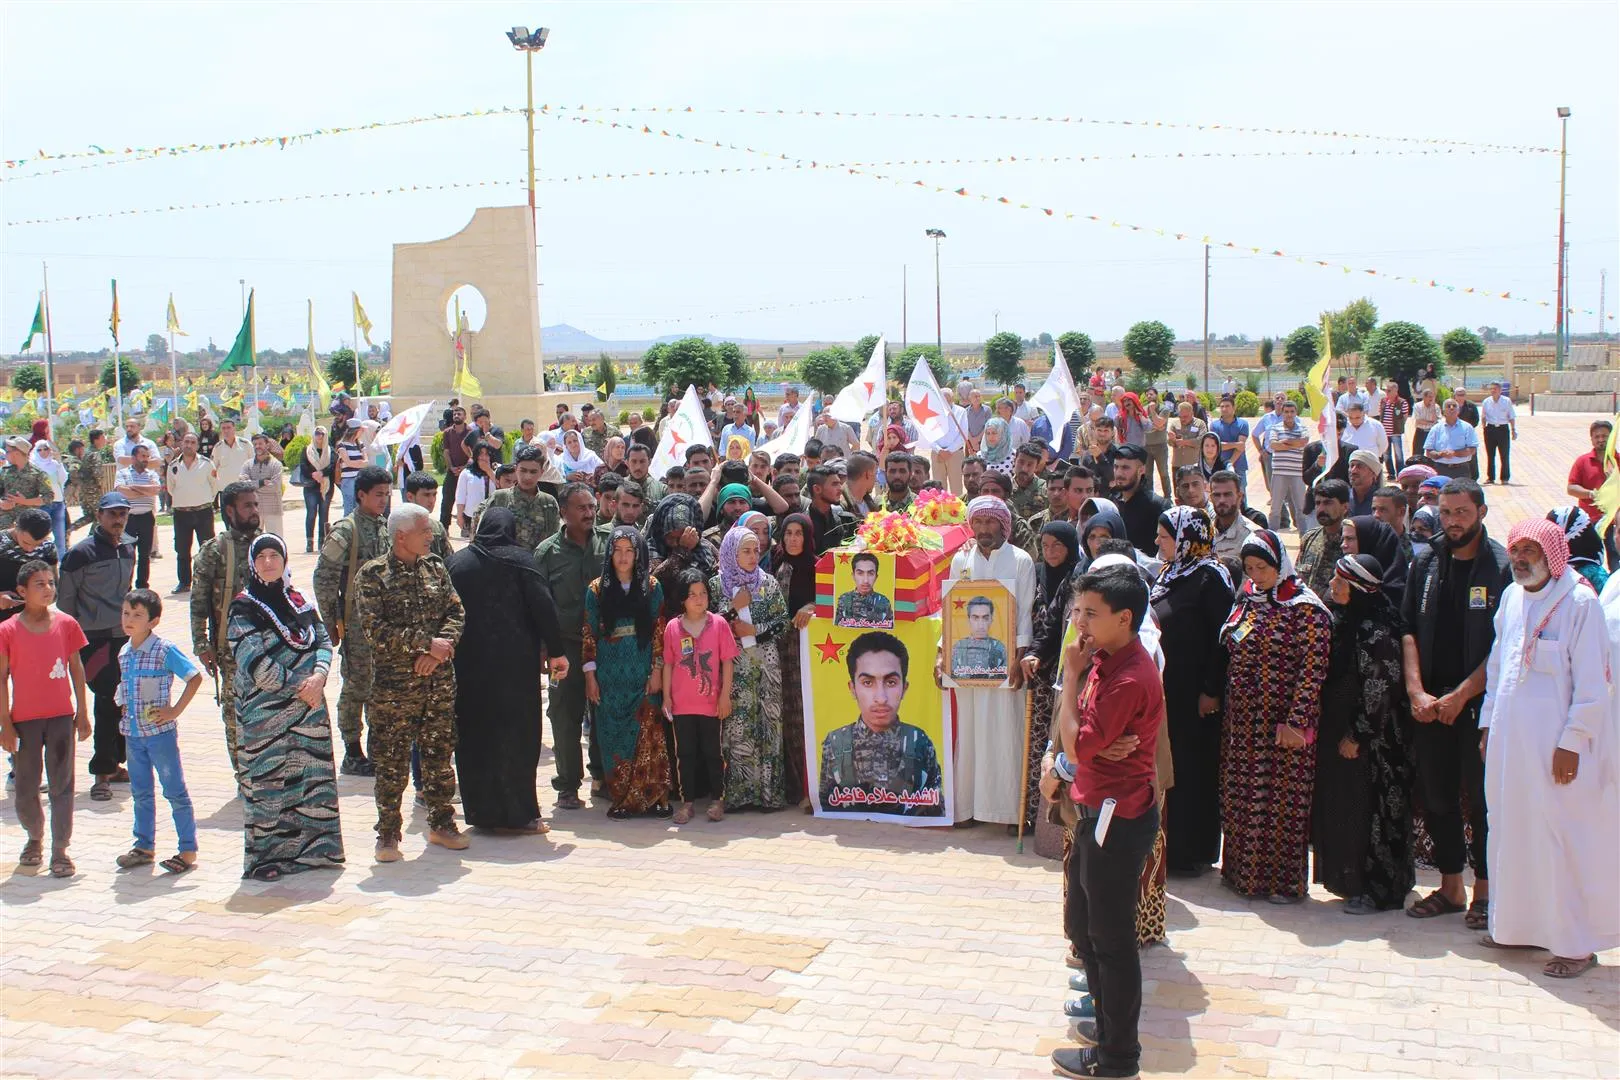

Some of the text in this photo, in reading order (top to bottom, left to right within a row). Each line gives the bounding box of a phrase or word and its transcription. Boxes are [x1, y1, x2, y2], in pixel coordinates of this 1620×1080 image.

[828, 786, 939, 808] الشهيد علاء فاضل
